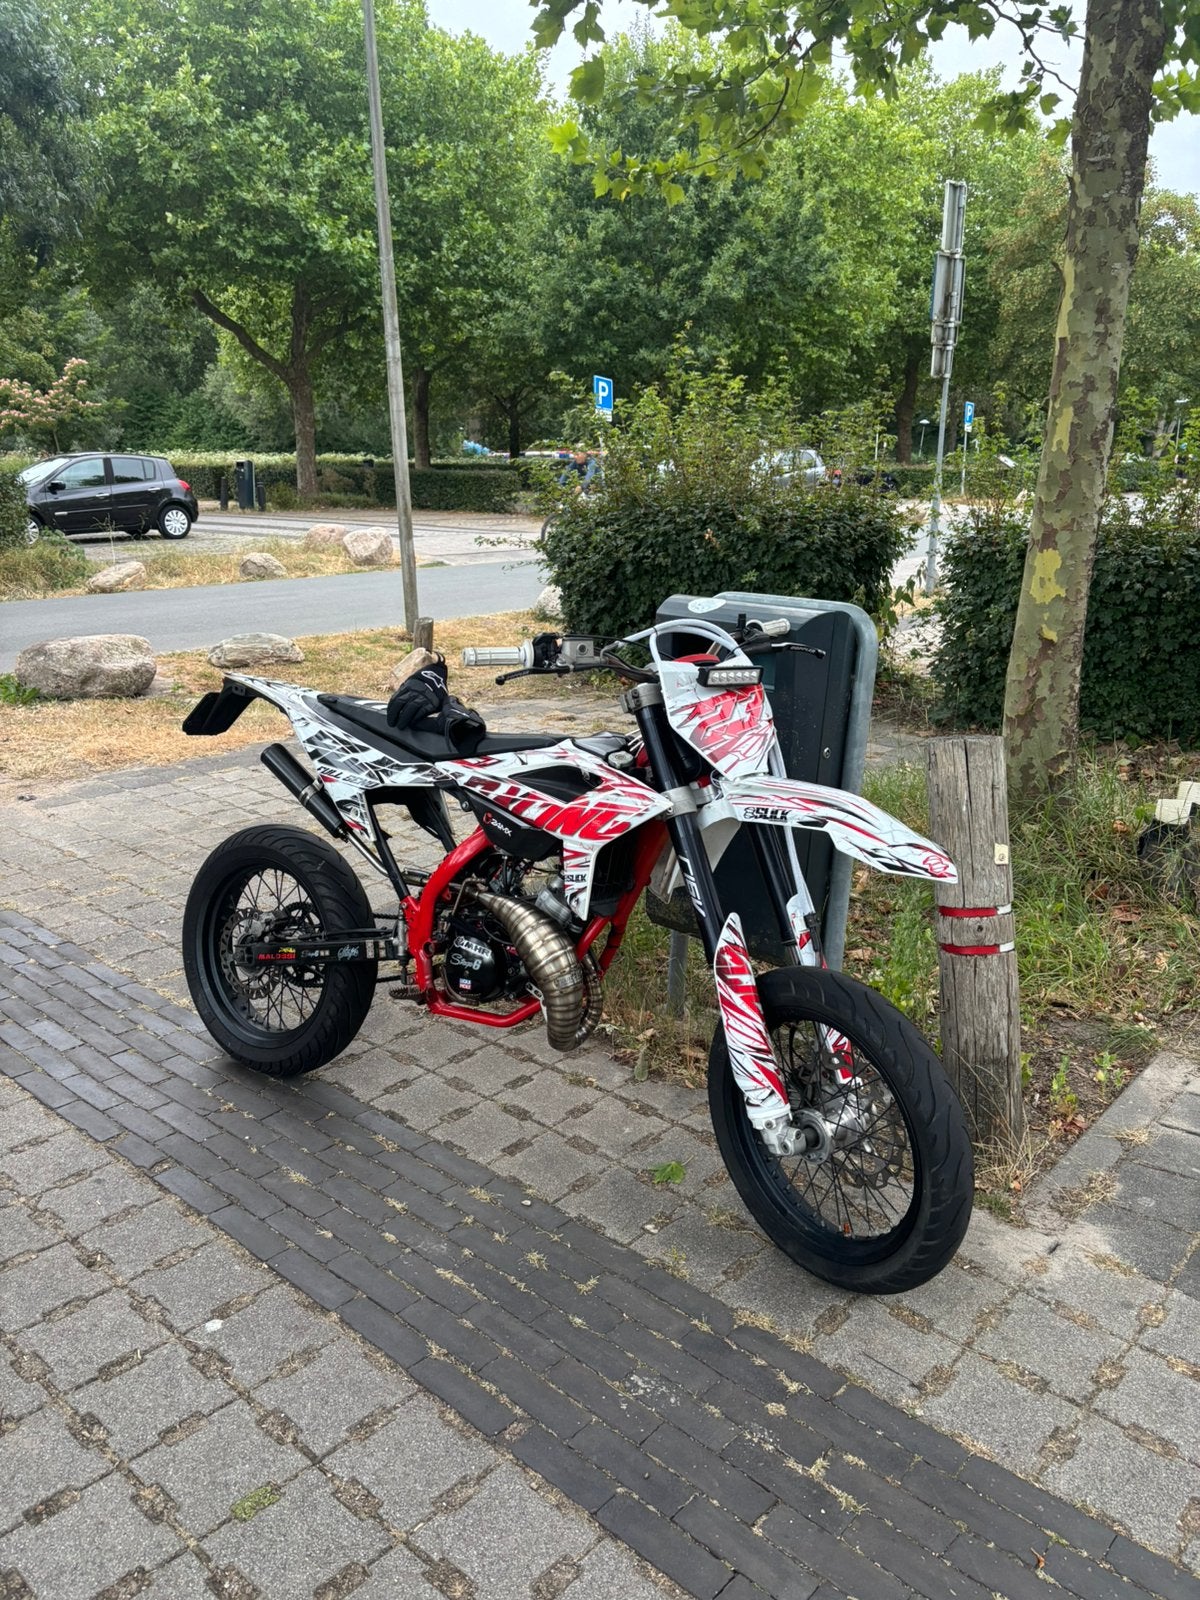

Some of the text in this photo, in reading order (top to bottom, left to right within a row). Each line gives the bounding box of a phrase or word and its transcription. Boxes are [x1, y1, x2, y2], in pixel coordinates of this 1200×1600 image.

[598, 381, 609, 404] P
[966, 405, 973, 421] P
[317, 766, 343, 779] FULL
[490, 818, 512, 837] 24MX
[257, 953, 297, 961] MALOSSI
[464, 941, 491, 957] MHR
[450, 953, 482, 970] Stage6
